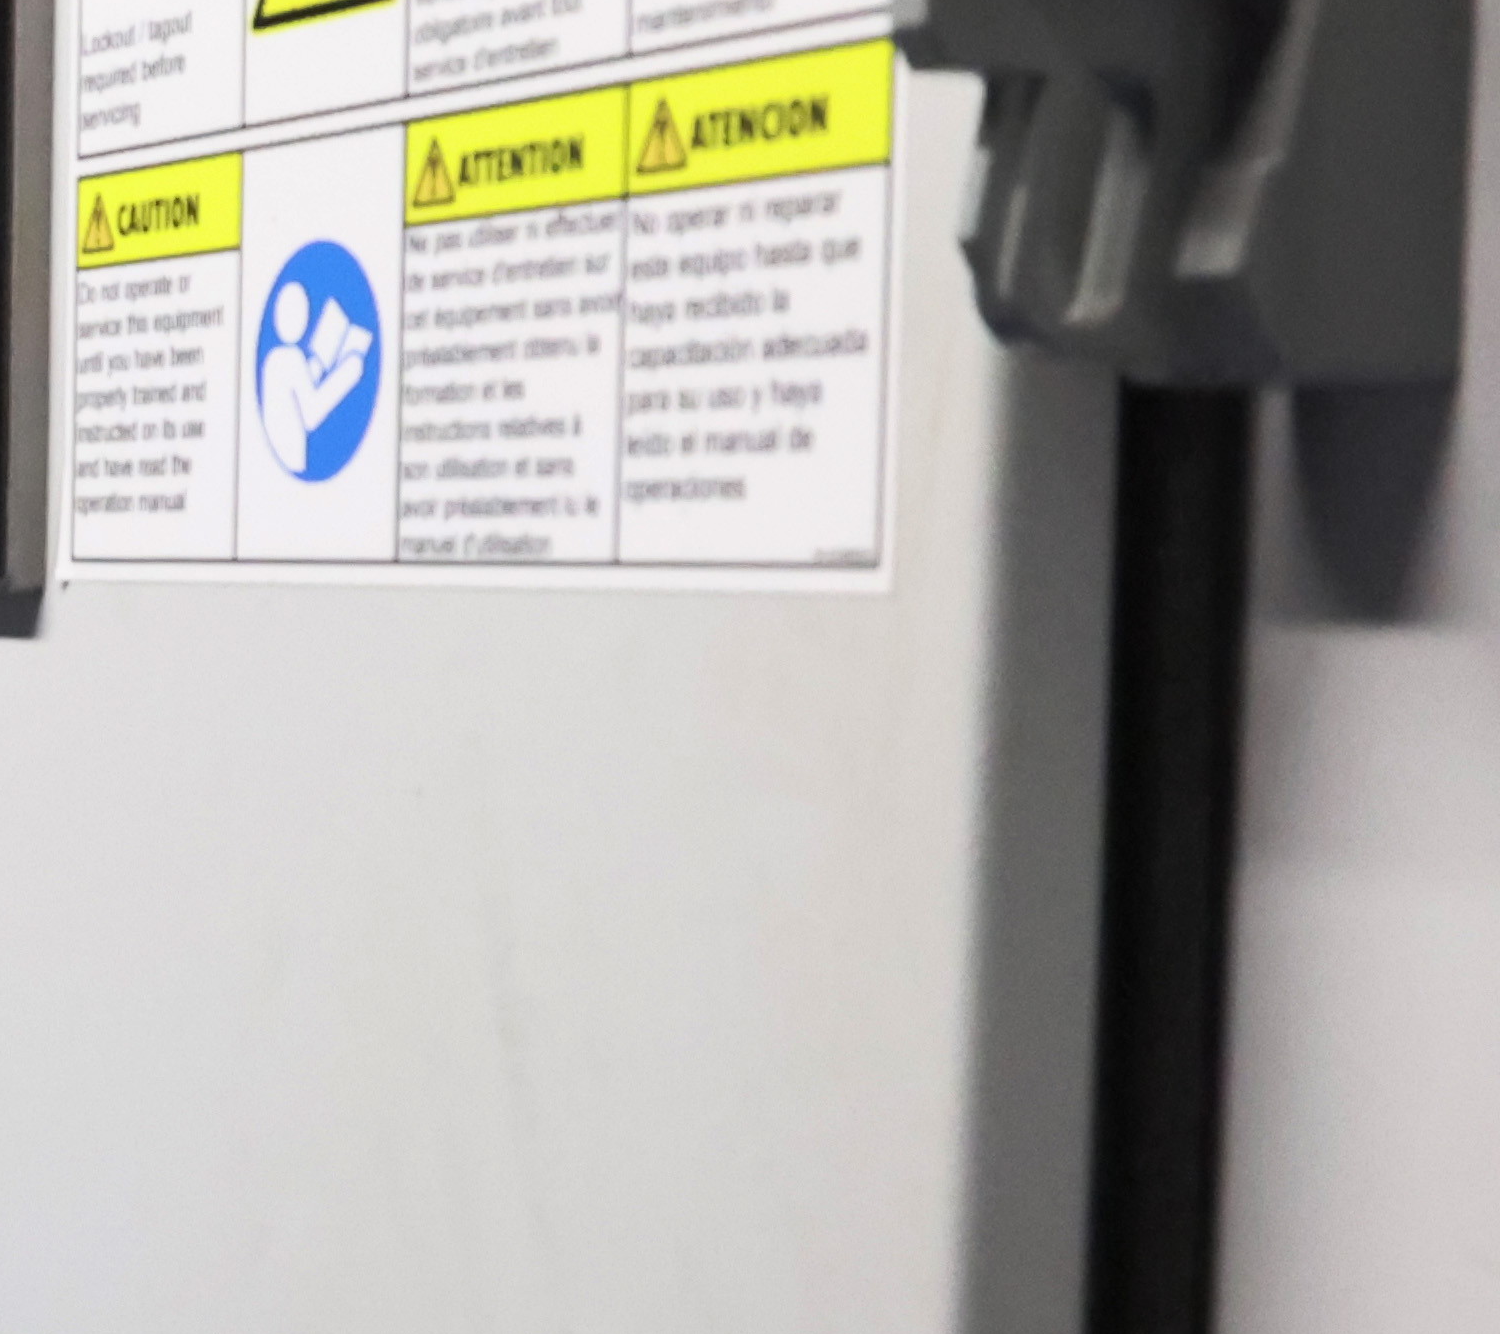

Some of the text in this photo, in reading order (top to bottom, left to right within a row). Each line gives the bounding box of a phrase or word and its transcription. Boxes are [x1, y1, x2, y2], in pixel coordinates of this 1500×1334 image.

[81, 23, 135, 57] Lockout
[148, 10, 192, 46] tagout
[82, 51, 185, 95] required before
[82, 102, 140, 135] servicing
[690, 94, 829, 153] ATENCION
[459, 133, 584, 187] ATTENTION
[117, 192, 200, 237] CAUTION
[153, 305, 224, 336] equipment
[134, 347, 164, 369] have
[171, 343, 204, 366] been
[181, 381, 206, 402] and
[104, 458, 132, 477] have
[138, 493, 186, 512] manual
